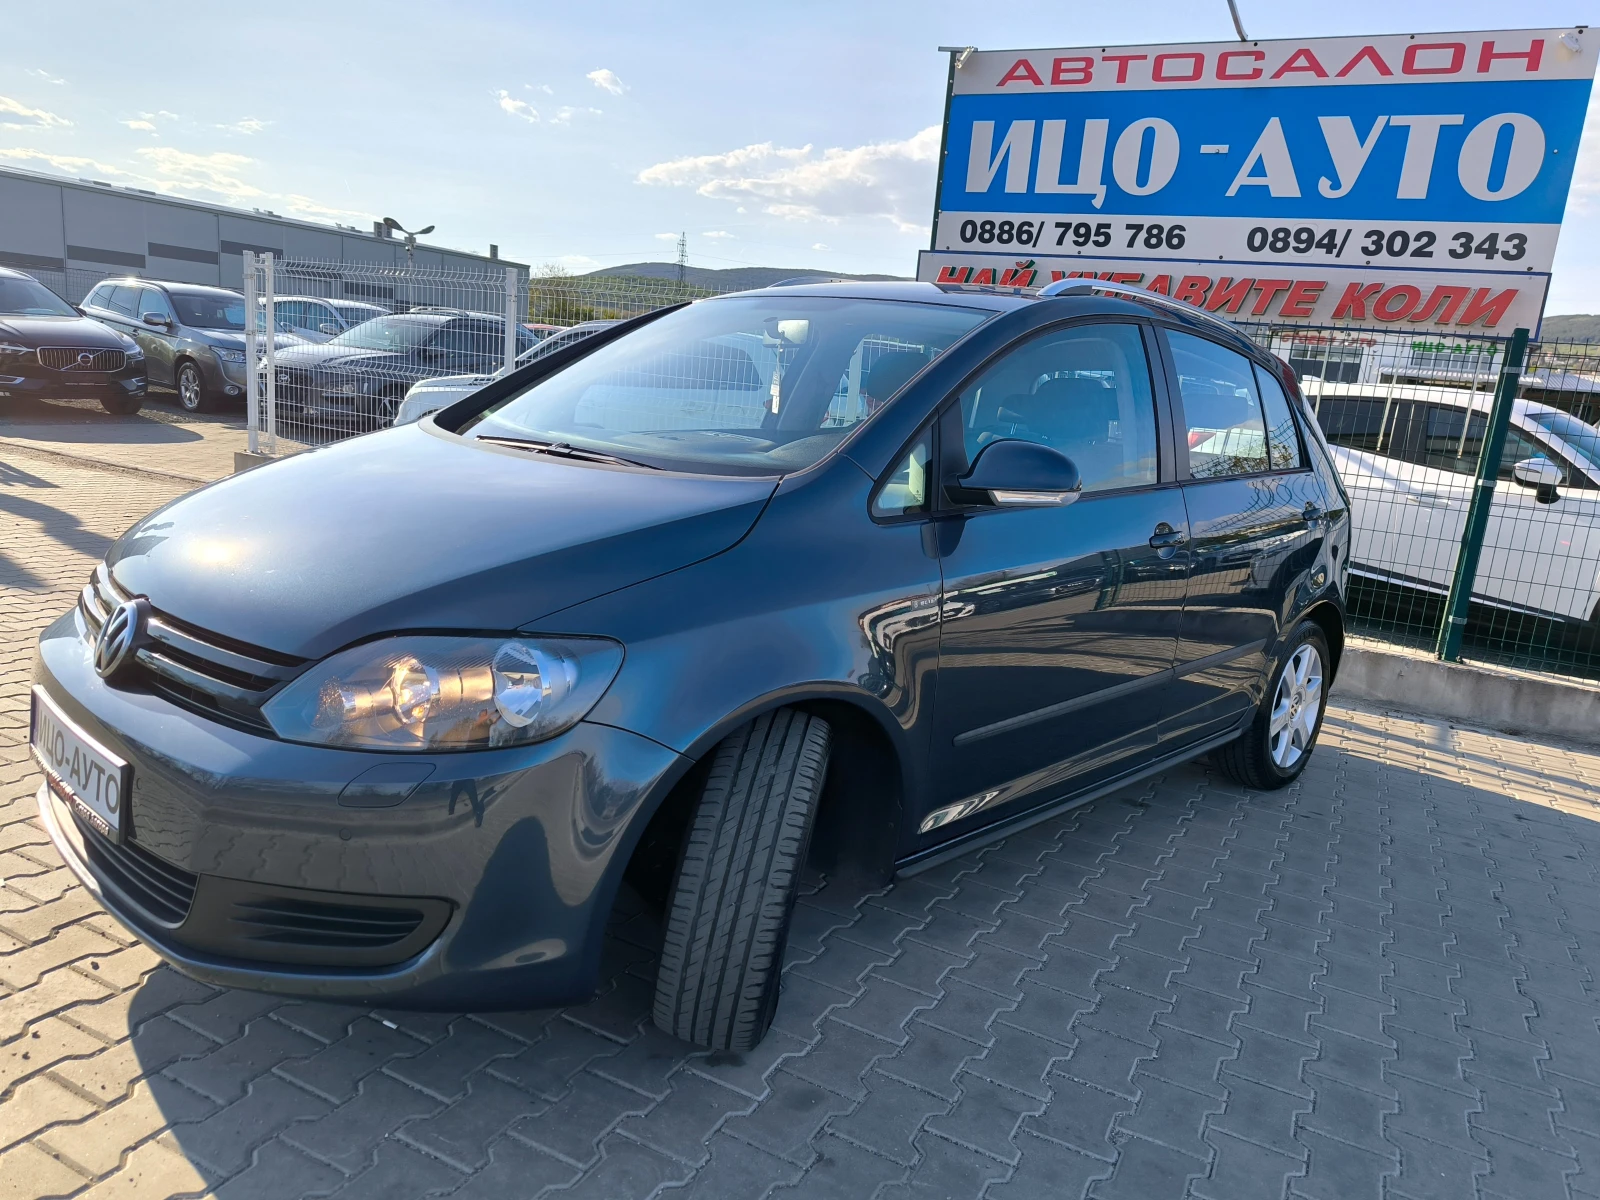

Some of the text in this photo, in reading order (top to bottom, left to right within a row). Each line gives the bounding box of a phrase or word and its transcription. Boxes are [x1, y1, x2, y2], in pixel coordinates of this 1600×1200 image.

[996, 39, 1545, 87] АВТОСАЛОН
[959, 219, 1187, 250] 0886/ 795 786
[1246, 226, 1528, 261] 0894/ 302 343
[1331, 281, 1520, 328] КОЛИ
[38, 709, 120, 815] ИЦО-АУТО
